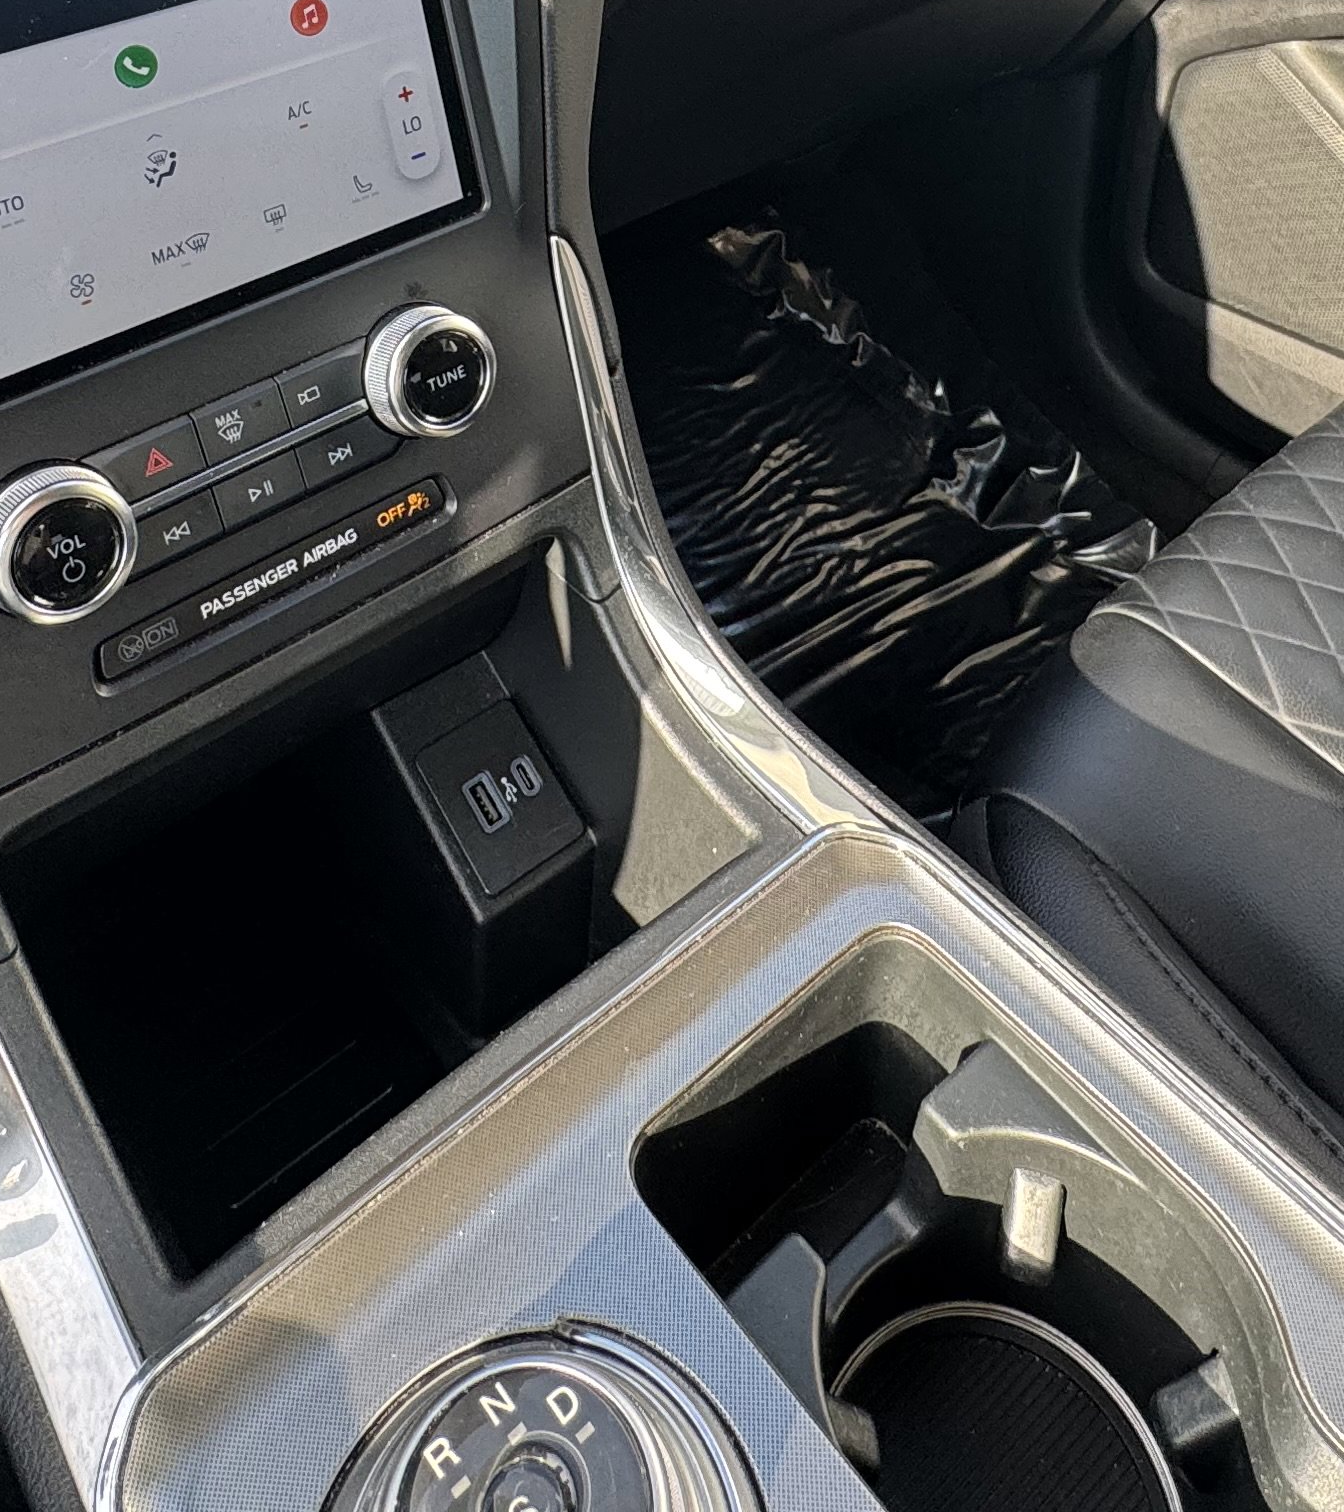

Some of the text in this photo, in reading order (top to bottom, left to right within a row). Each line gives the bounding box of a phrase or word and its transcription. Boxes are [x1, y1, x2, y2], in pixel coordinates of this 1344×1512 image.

[287, 100, 313, 121] A/C
[402, 115, 422, 135] LO
[151, 240, 187, 266] MAX
[426, 365, 468, 394] TUNE
[214, 408, 242, 429] MAX
[376, 502, 407, 528] OFF
[47, 536, 86, 560] VOL
[200, 527, 359, 620] PASSENGER AIRBAG
[147, 621, 175, 645] ON
[479, 1381, 516, 1427] N
[545, 1386, 580, 1425] D
[423, 1437, 461, 1480] R
